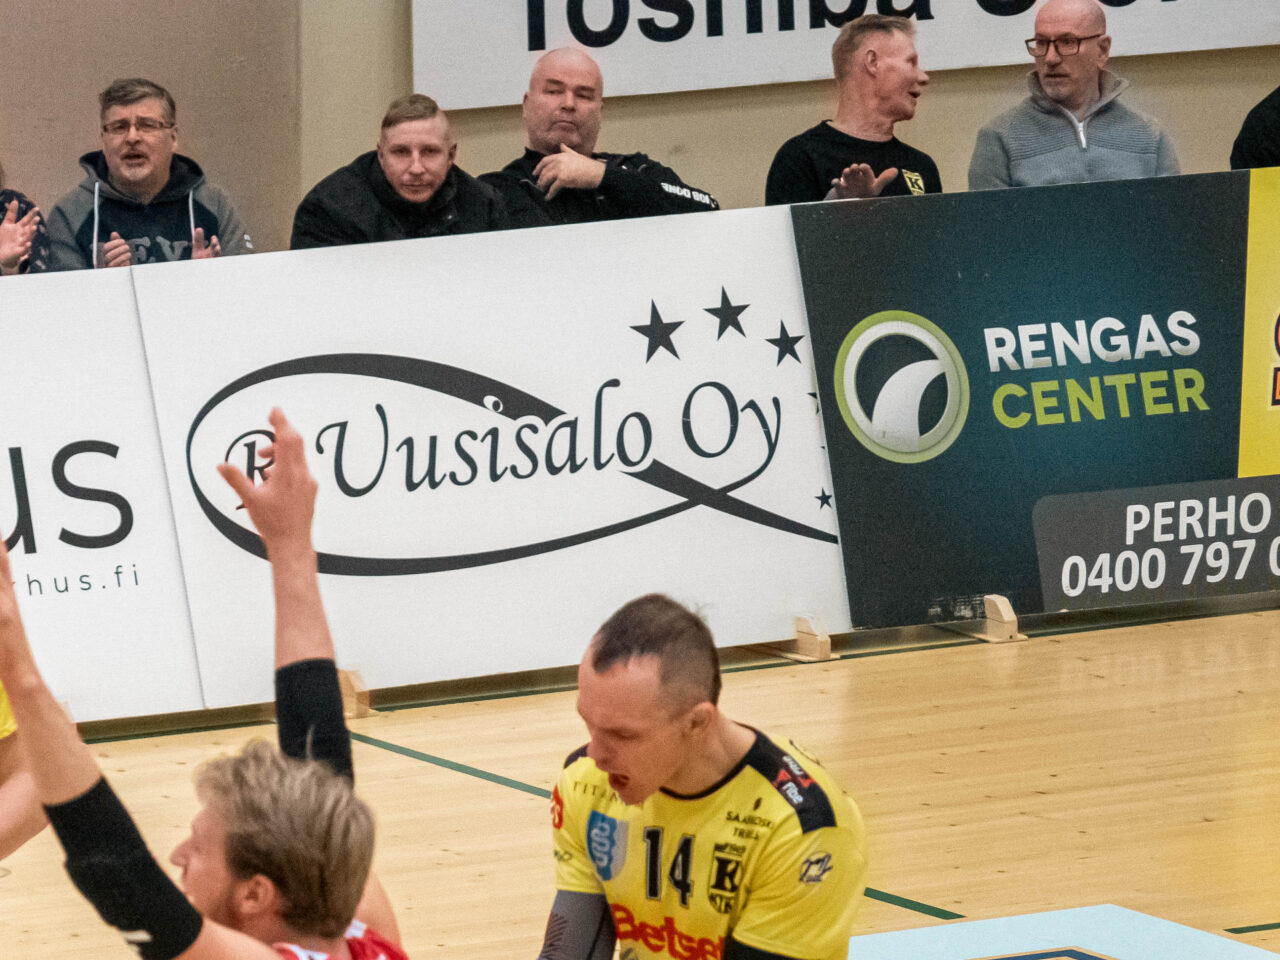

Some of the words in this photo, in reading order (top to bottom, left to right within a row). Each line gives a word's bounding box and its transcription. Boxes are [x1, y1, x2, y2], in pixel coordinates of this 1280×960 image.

[983, 310, 1201, 373] RENGAS
[992, 367, 1211, 429] CENTER
[316, 378, 654, 498] Uusisalo
[681, 380, 783, 495] Oy
[1125, 492, 1272, 546] PERHO
[12, 563, 140, 597] hus.fi
[1061, 550, 1167, 597] 0400
[1179, 538, 1257, 586] 797
[643, 825, 695, 909] 14
